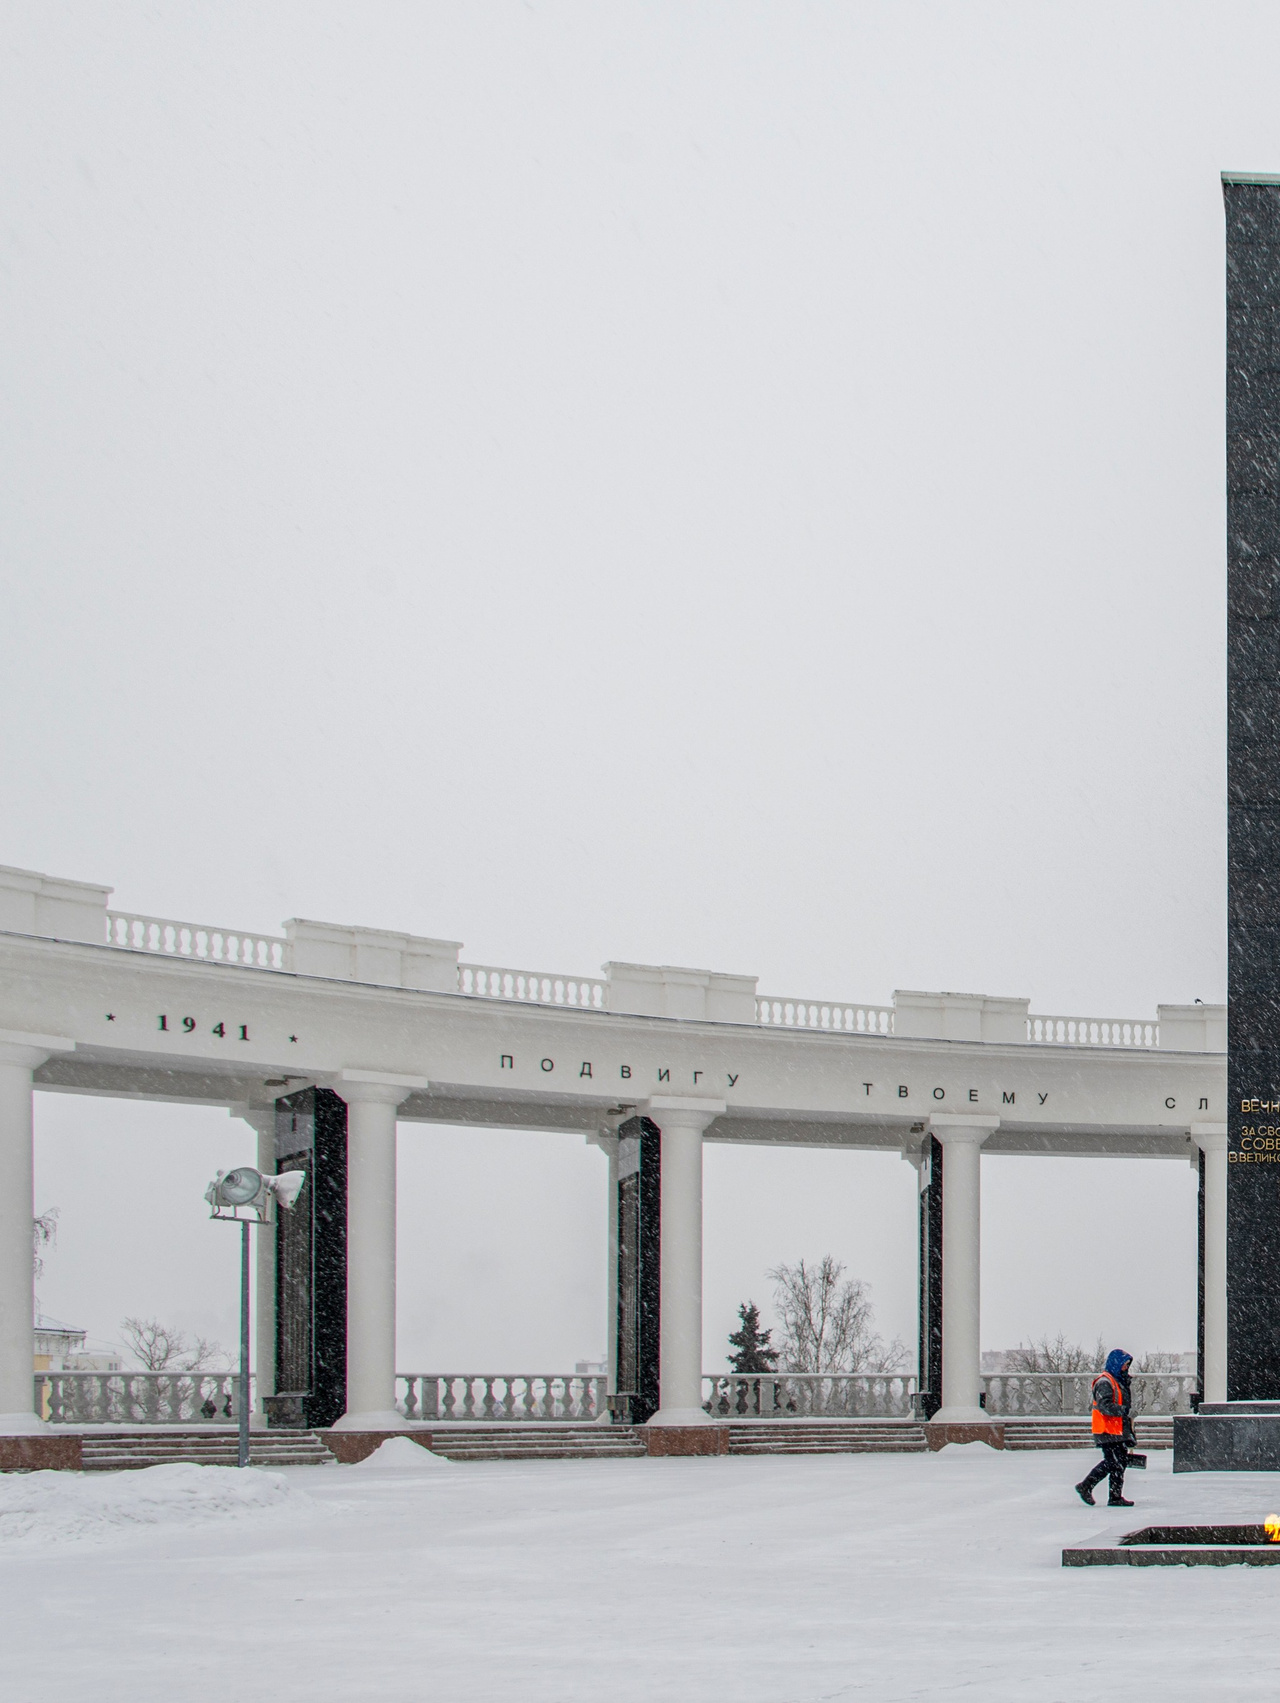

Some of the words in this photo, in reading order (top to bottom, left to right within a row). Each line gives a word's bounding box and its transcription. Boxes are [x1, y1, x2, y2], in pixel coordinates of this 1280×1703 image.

[158, 1014, 250, 1042] 1941
[500, 1054, 739, 1088] ПОДВИГУ
[862, 1082, 1049, 1106] ТВОЕМУ
